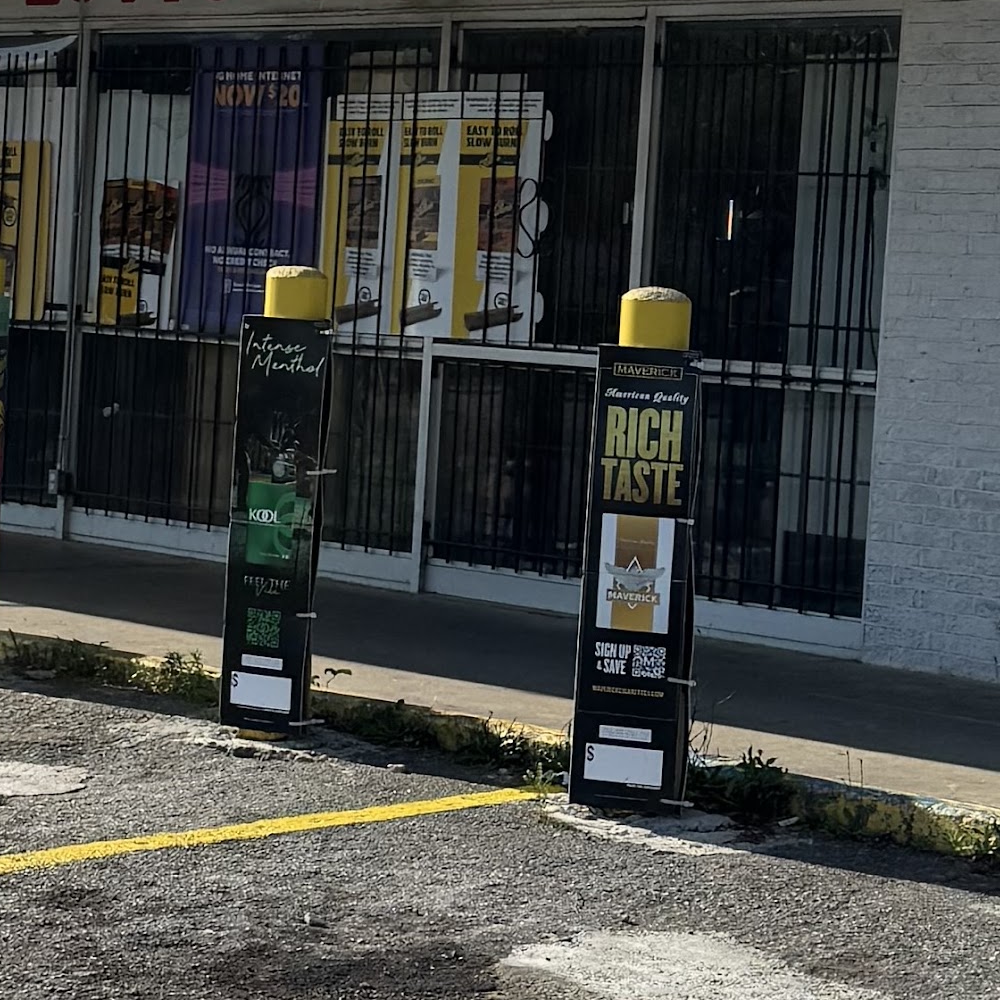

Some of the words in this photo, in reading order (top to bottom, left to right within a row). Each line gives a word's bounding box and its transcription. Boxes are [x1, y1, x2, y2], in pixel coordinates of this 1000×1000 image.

[246, 330, 307, 356] Intense
[251, 350, 326, 377] Menthol
[617, 364, 679, 378] MAVERICK
[653, 391, 690, 406] Quality
[604, 405, 684, 463] RICH
[601, 457, 685, 507] TASTE
[248, 507, 281, 524] KOOL
[607, 590, 658, 604] MAVERICK
[594, 641, 618, 659] SIGN
[618, 643, 632, 660] UP
[603, 658, 628, 675] SAVE
